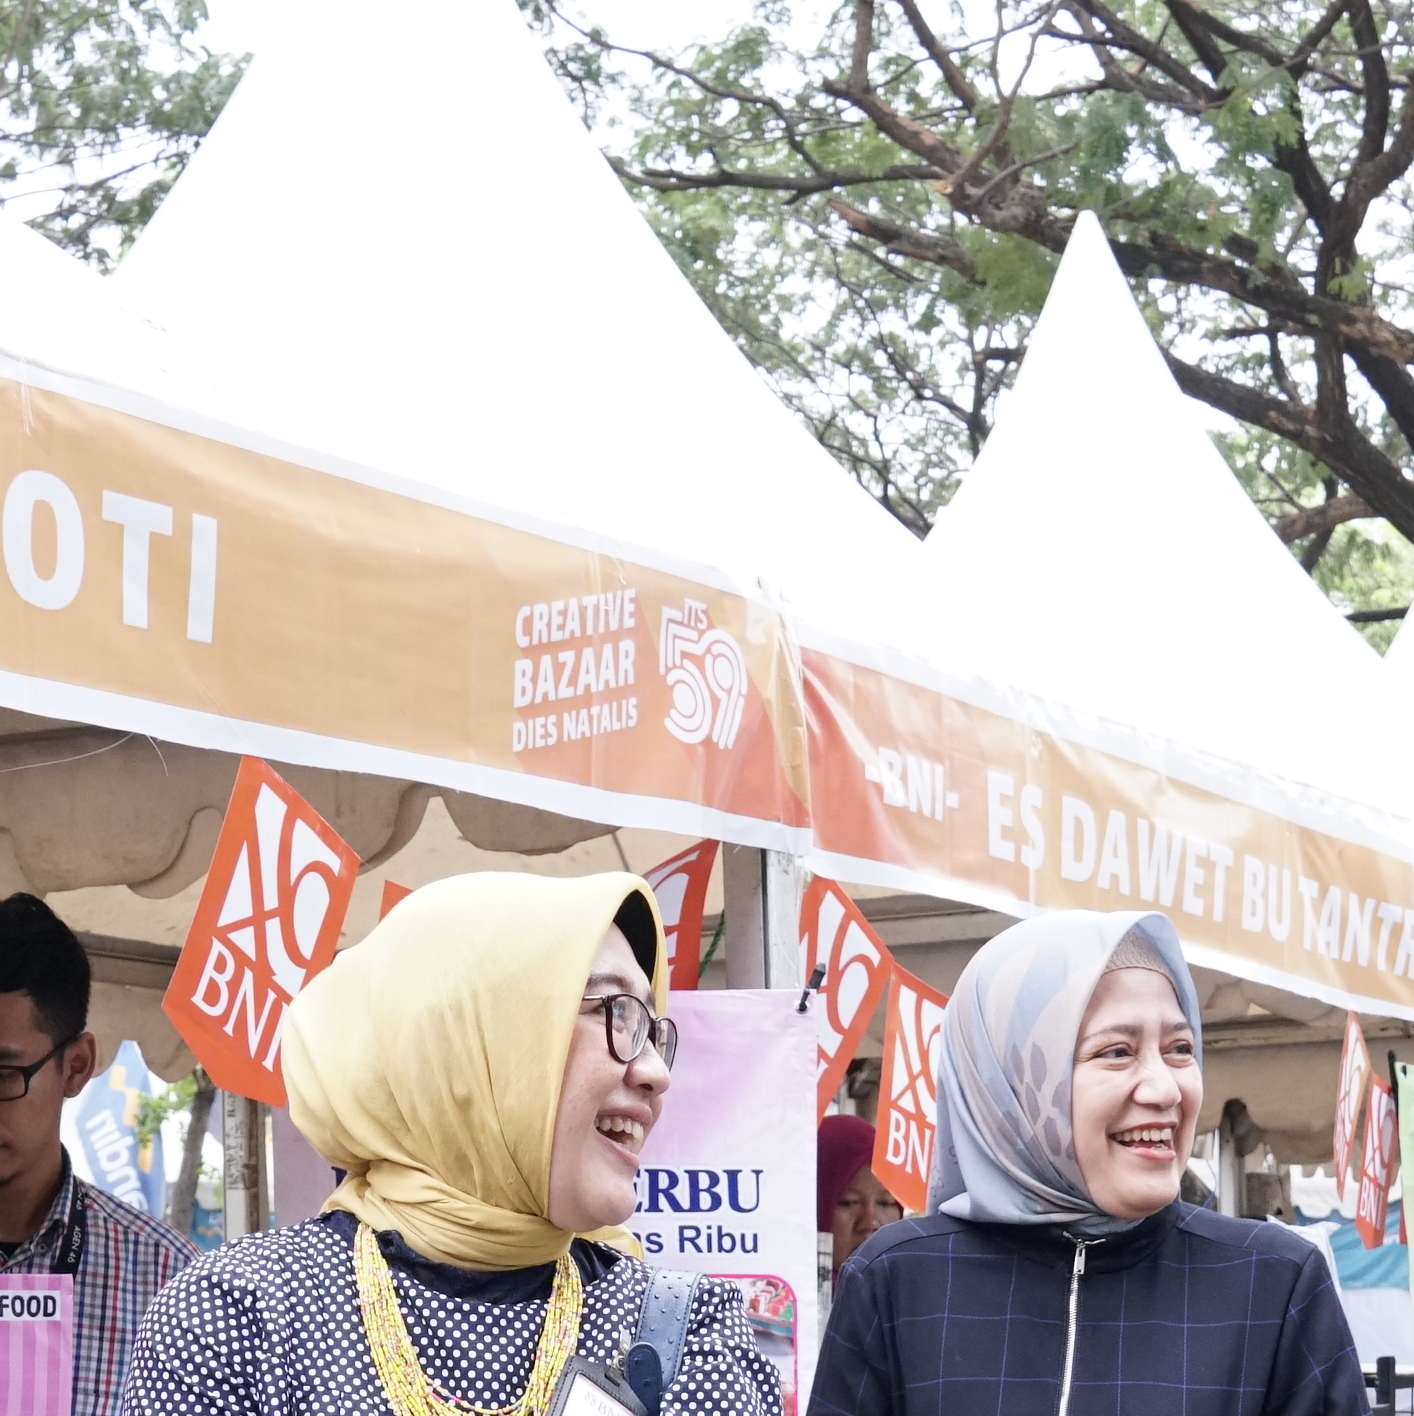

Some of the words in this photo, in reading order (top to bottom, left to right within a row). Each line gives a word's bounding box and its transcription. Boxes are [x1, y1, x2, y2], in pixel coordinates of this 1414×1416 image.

[515, 588, 636, 648] CREATIVE
[684, 598, 708, 630] ITS
[513, 639, 635, 708] BAZAAR
[512, 714, 557, 753] DIES
[563, 697, 638, 742] NATALIS
[988, 769, 1045, 869] ES
[1061, 795, 1235, 916] DAWET
[1241, 855, 1289, 943] BU
[190, 936, 289, 1073] BNI
[886, 1112, 932, 1184] BN
[67, 1251, 76, 1263] 46
[71, 1225, 82, 1251] AGEN
[678, 1225, 758, 1254] Ribu
